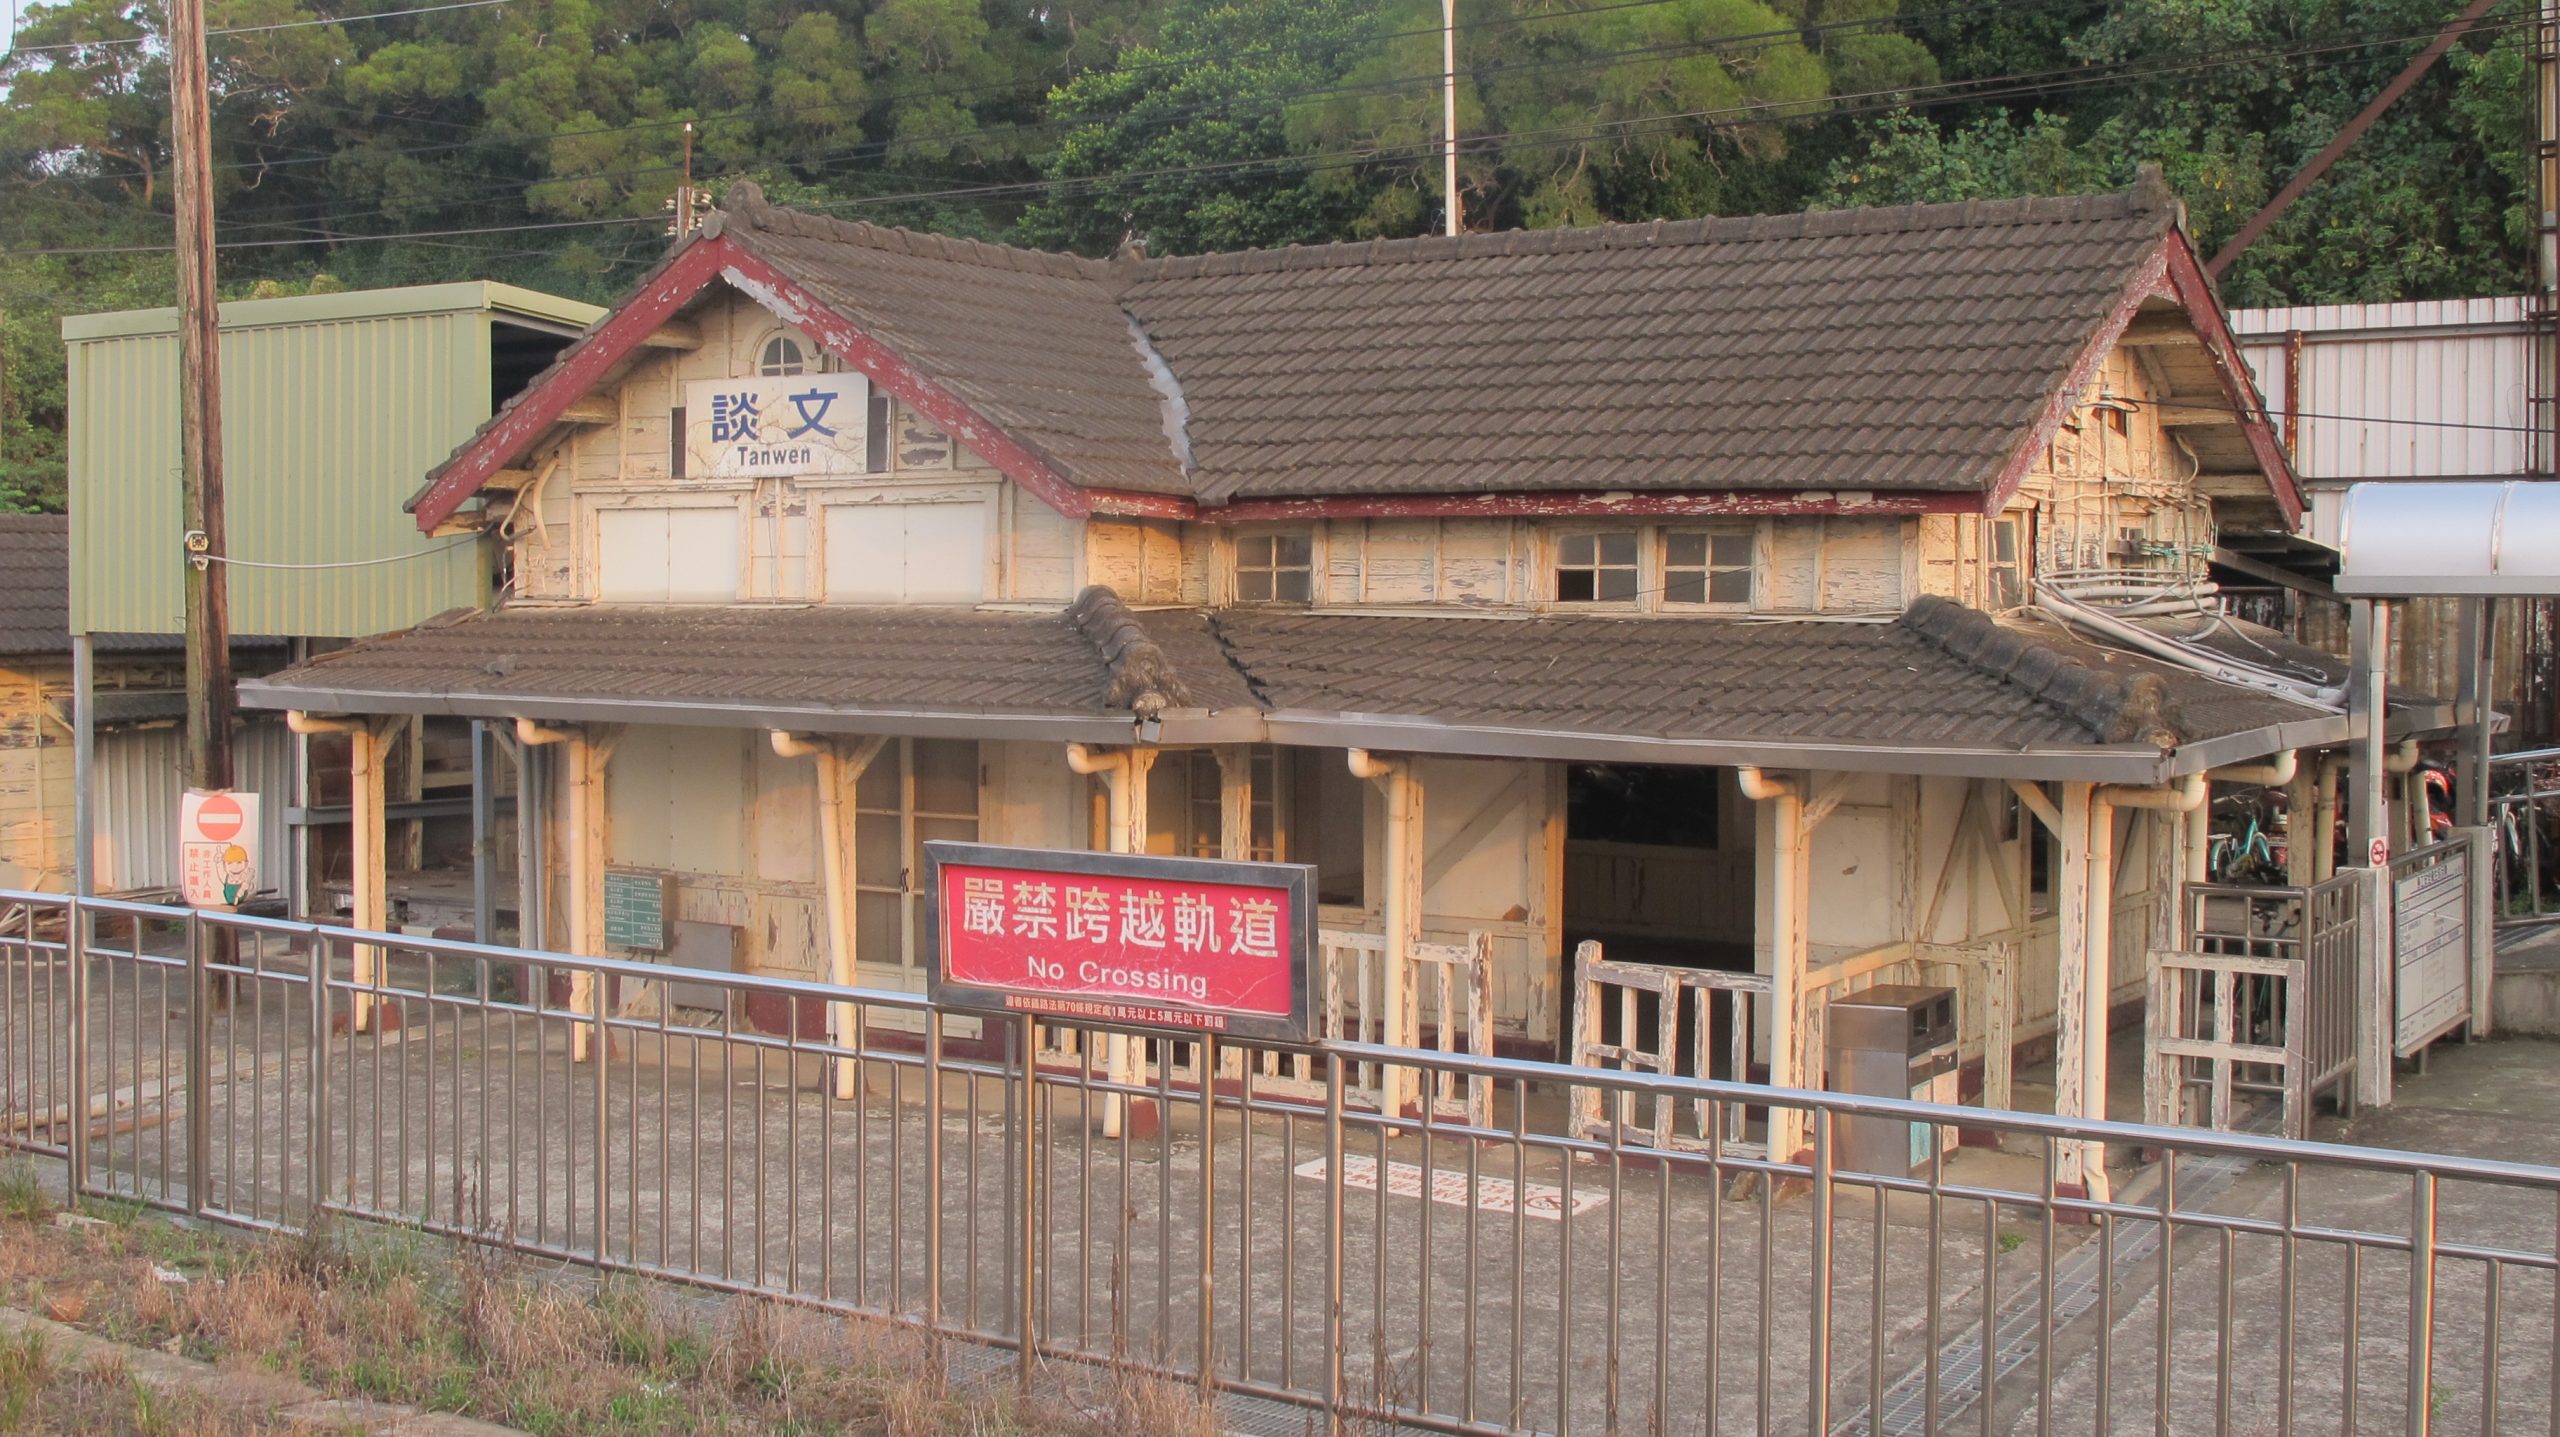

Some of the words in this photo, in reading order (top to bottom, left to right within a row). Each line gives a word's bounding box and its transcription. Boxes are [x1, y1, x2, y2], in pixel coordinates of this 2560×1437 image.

[711, 388, 839, 443] 談文
[737, 446, 811, 466] Tanwen
[963, 876, 1280, 958] 嚴禁跨越軌道
[1027, 956, 1065, 981] No
[1078, 960, 1208, 998] Crossing
